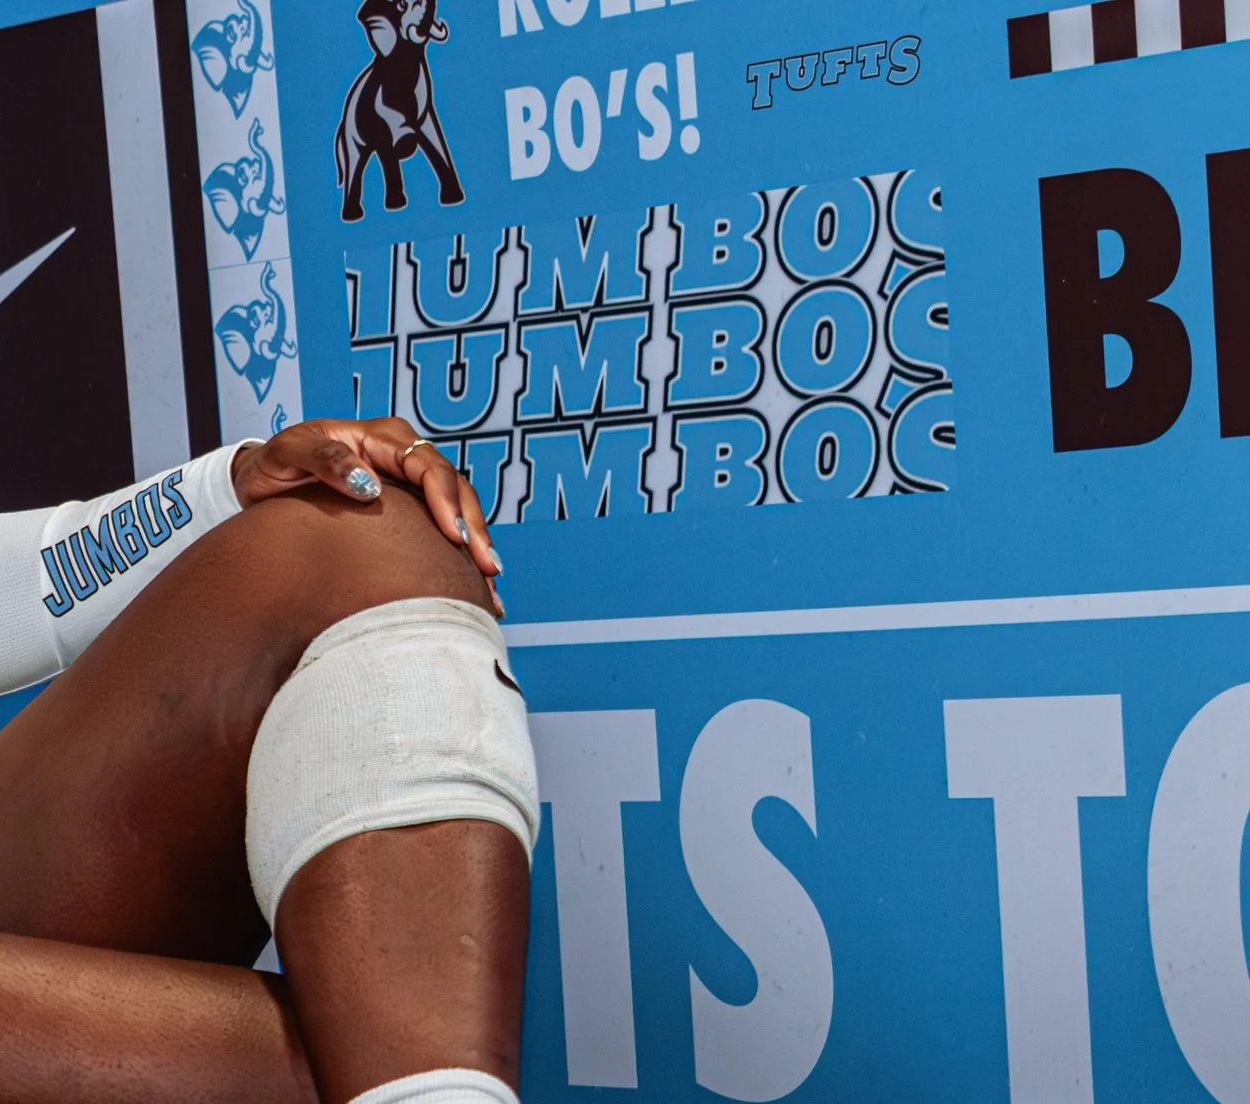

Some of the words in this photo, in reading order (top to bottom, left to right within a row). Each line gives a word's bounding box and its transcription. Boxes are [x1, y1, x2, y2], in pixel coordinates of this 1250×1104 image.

[504, 51, 701, 181] BO'S!
[746, 34, 923, 110] TUFTS
[41, 468, 193, 618] JUMBOS
